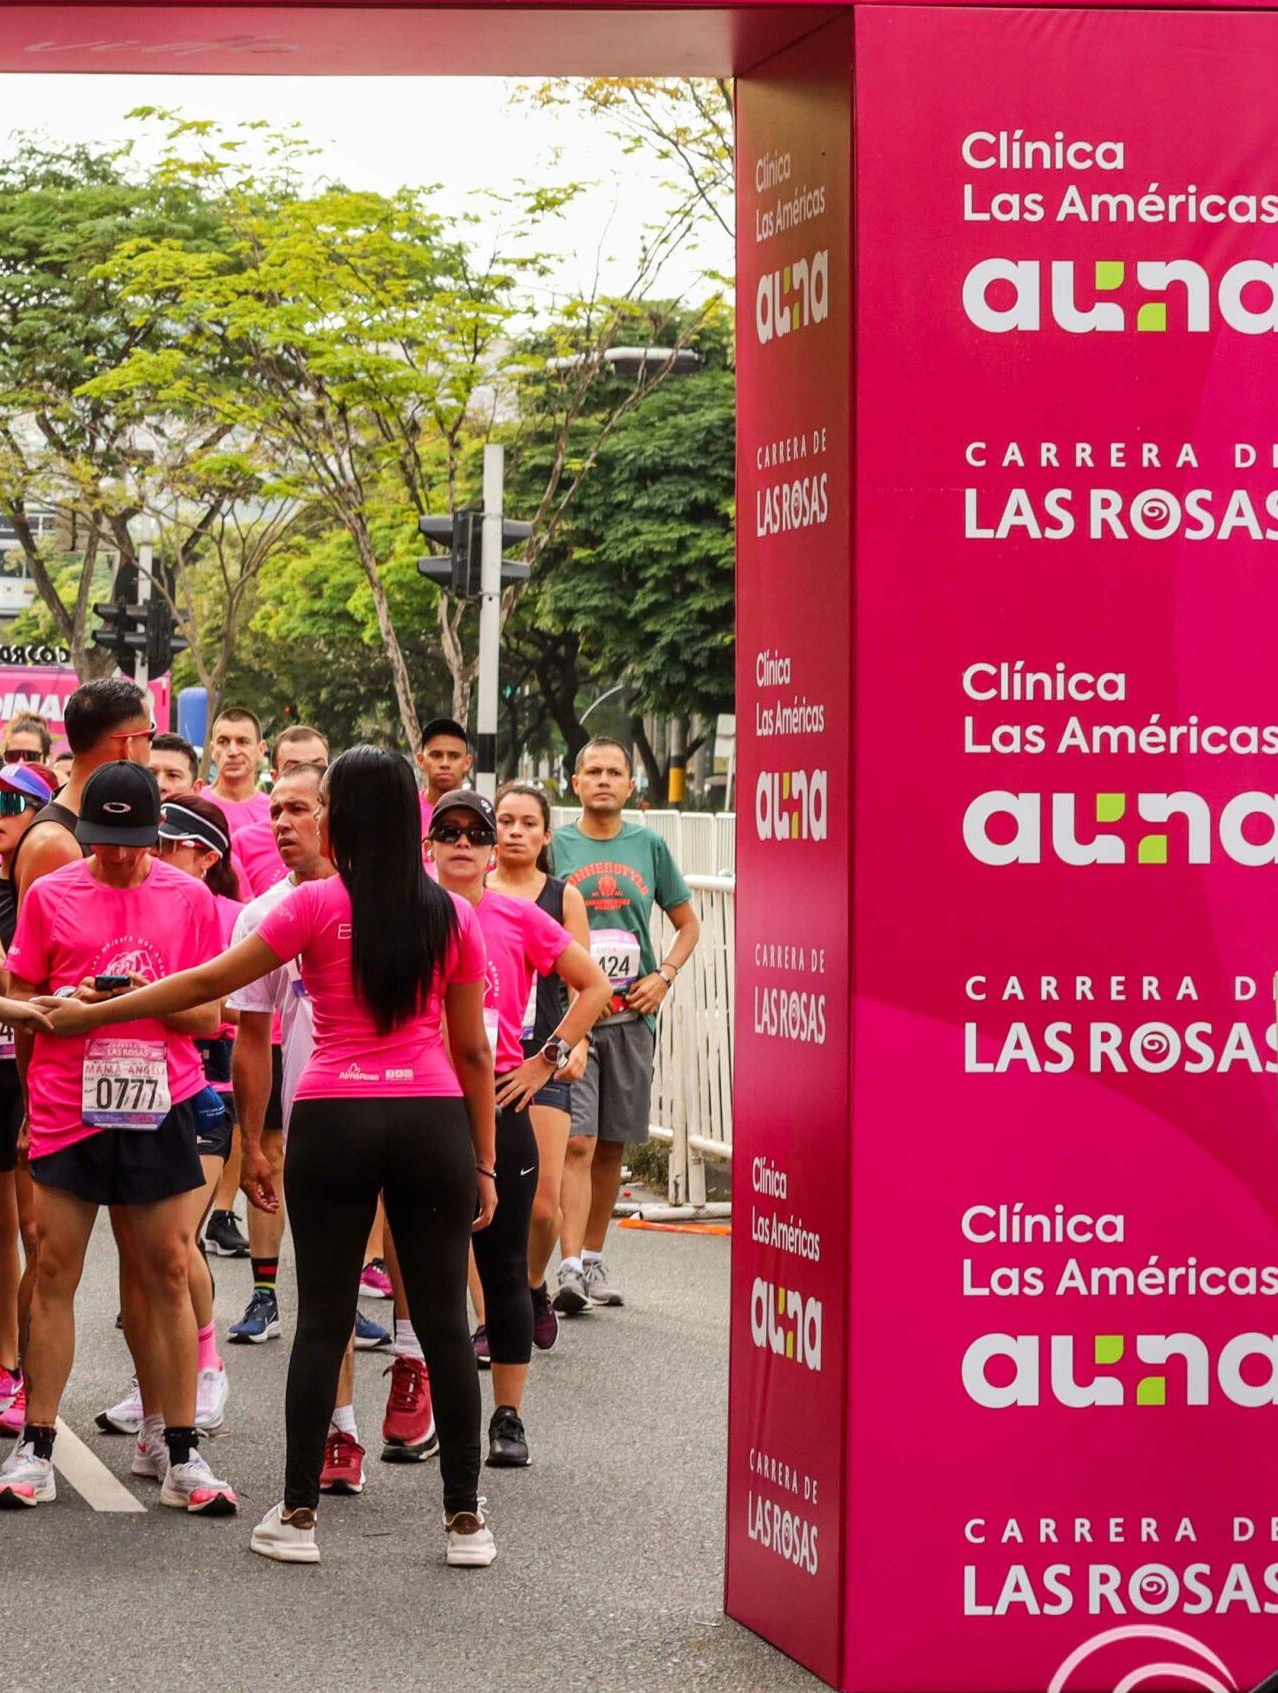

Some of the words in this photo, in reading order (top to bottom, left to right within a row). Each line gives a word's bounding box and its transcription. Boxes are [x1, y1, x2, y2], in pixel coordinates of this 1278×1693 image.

[962, 130, 1123, 169] Clínica
[756, 151, 790, 192] Clínica
[756, 209, 773, 242] Las
[773, 181, 825, 234] Américas
[964, 184, 1044, 221] Las
[756, 250, 827, 344] auna
[757, 435, 806, 469] CARRERA
[814, 428, 826, 454] DE
[966, 442, 1198, 467] CARRERA
[1235, 444, 1278, 468] D
[757, 486, 780, 536] LAS
[783, 473, 827, 531] ROSAS
[965, 489, 1074, 539] LAS
[757, 650, 790, 687] Clínica
[963, 661, 1125, 701] Clínica
[757, 703, 773, 736] Las
[775, 696, 824, 734] Américas
[965, 716, 1045, 753] Las
[756, 769, 827, 841] auna
[755, 944, 804, 970] CARRERA
[812, 949, 824, 973] DE
[966, 976, 1198, 1000] CARRERA
[1235, 972, 1278, 1003] D
[755, 987, 777, 1035] LAS
[780, 990, 825, 1044] ROSAS
[965, 1022, 1074, 1073] LAS
[96, 1078, 158, 1110] 0777
[753, 1157, 786, 1199] Clínica
[752, 1210, 769, 1244] Las
[771, 1213, 819, 1261] Américas
[962, 1203, 1124, 1243] Clínica
[964, 1259, 1044, 1296] Las
[751, 1277, 821, 1371] auna
[750, 1448, 797, 1494] CARRERA
[805, 1476, 817, 1504] DE
[749, 1491, 771, 1547] LAS
[773, 1497, 817, 1575] ROSAS
[965, 1518, 1196, 1543] CARRERA
[964, 1564, 1073, 1615] LAS
